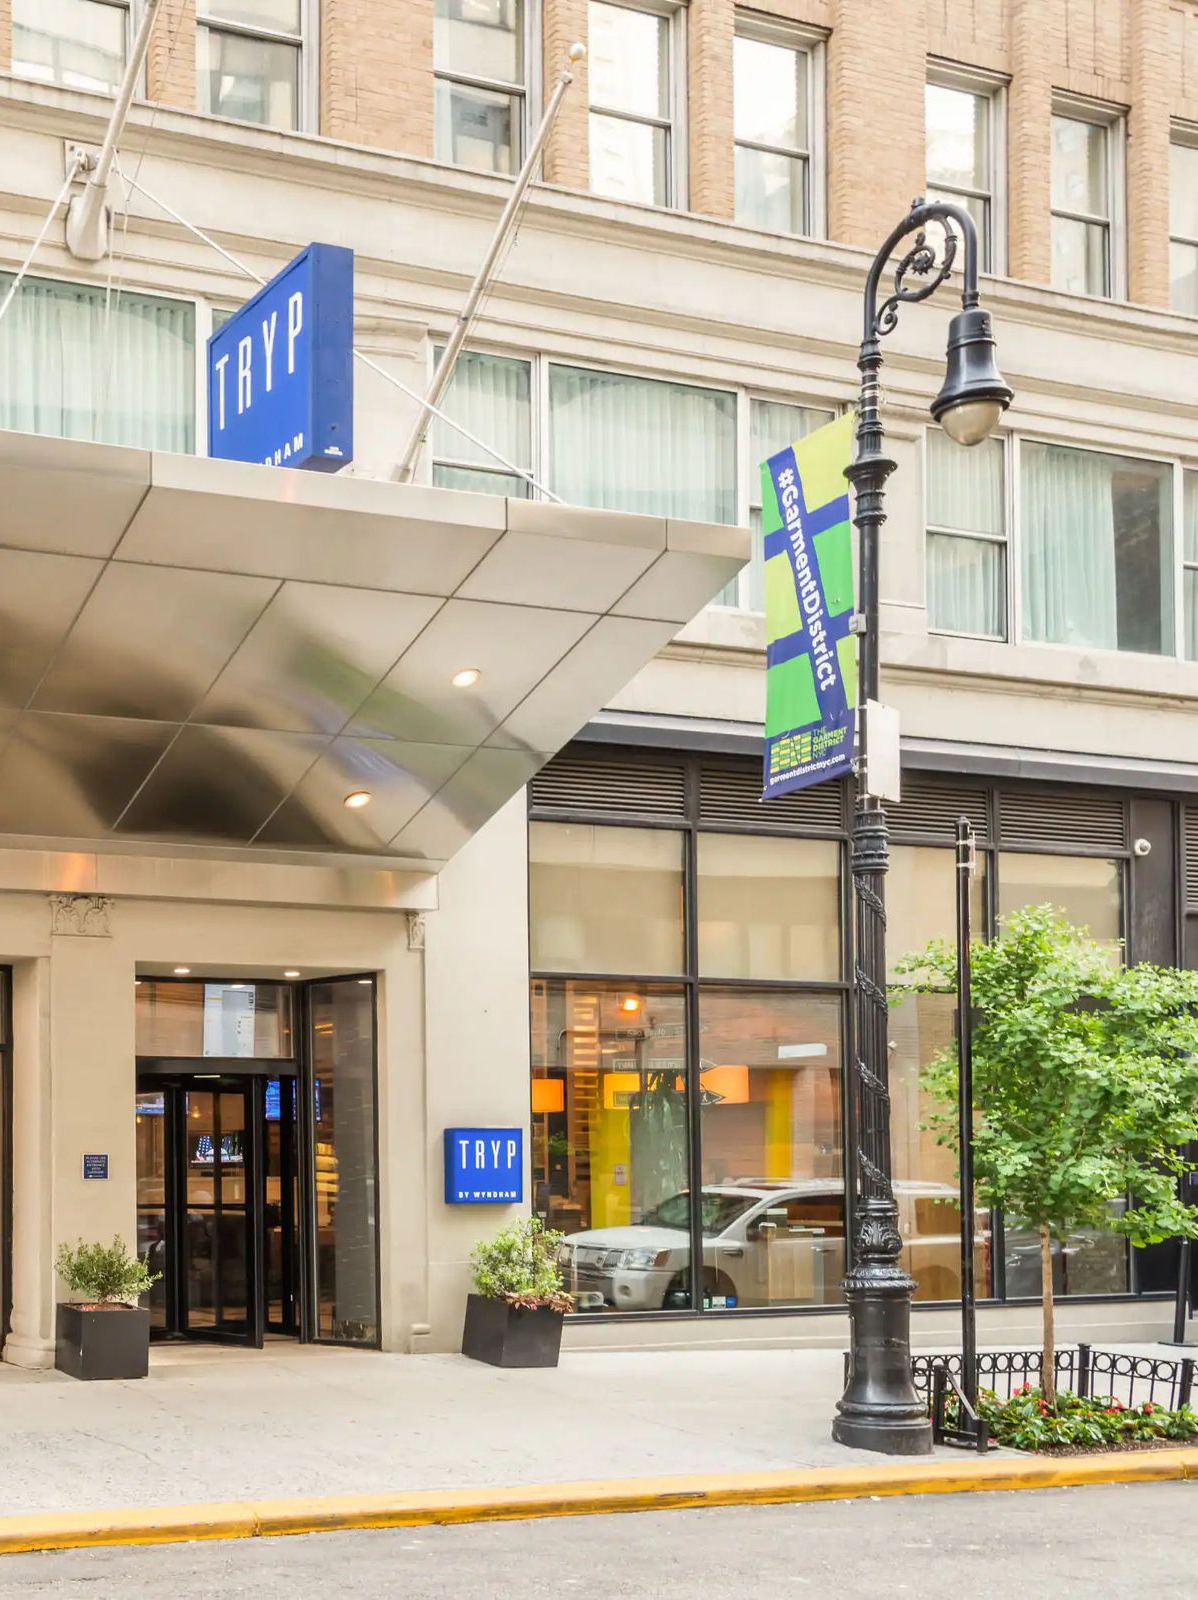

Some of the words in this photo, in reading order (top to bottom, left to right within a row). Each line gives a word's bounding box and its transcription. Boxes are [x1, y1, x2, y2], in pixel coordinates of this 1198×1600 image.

[215, 291, 303, 431] TRYP
[778, 468, 837, 692] #GarmentDistrict
[812, 726, 827, 737] THE
[812, 726, 848, 744] GARMENT
[812, 735, 844, 752] DISTRICT
[769, 753, 846, 786] garmentdistrictnyc.com
[458, 1139, 517, 1170] TRYP
[458, 1191, 469, 1199] BY
[473, 1190, 517, 1199] WYNDHAM
